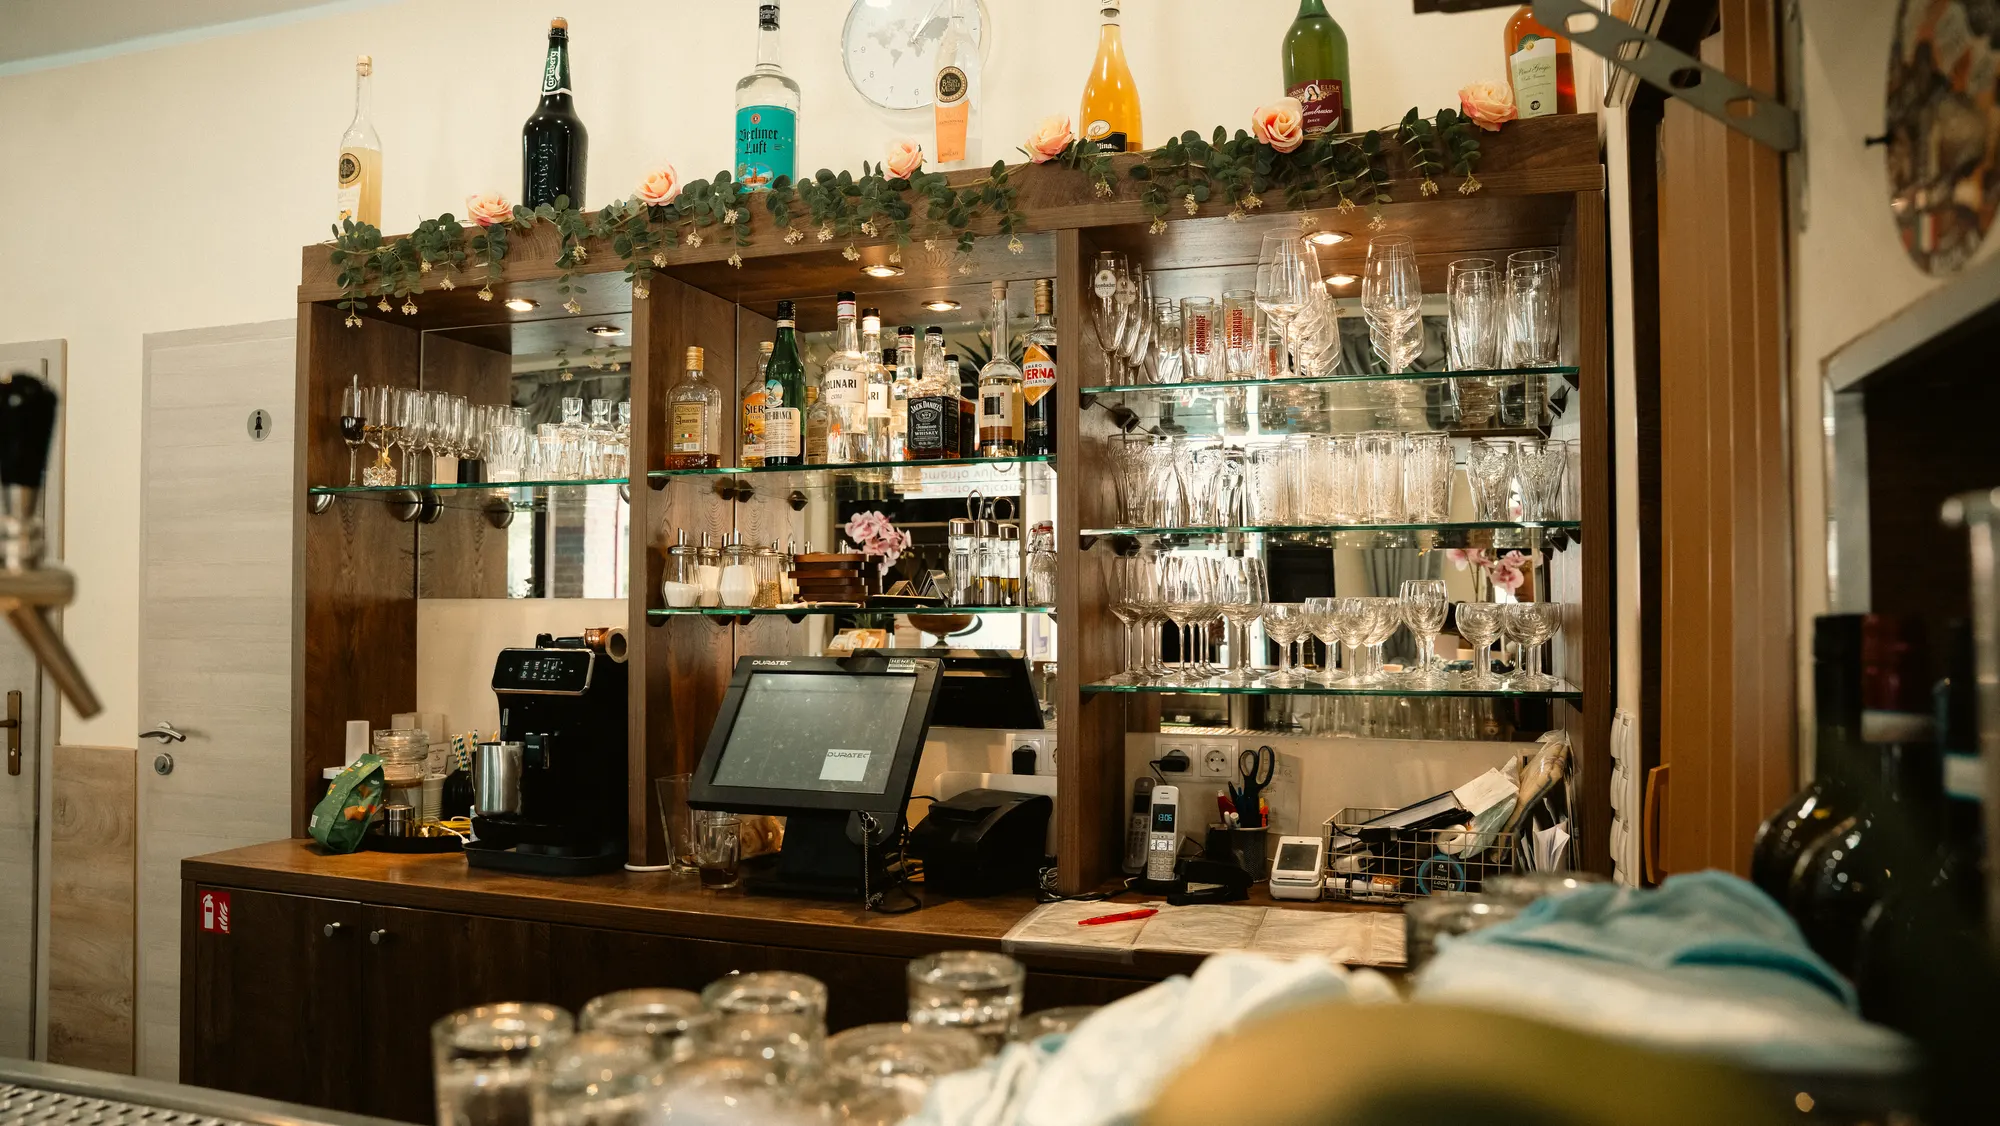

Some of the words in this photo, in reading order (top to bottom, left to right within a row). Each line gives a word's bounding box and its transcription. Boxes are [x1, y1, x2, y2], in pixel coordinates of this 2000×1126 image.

[860, 46, 866, 54] 9
[544, 50, 559, 90] Carlsberg
[869, 71, 875, 79] 8
[914, 88, 920, 96] 6
[739, 127, 779, 142] Berliner
[744, 140, 767, 156] Luft
[1196, 315, 1206, 354] FASSBRAUSE
[1232, 308, 1243, 349] FASSBRAUSE
[911, 402, 922, 414] JACK
